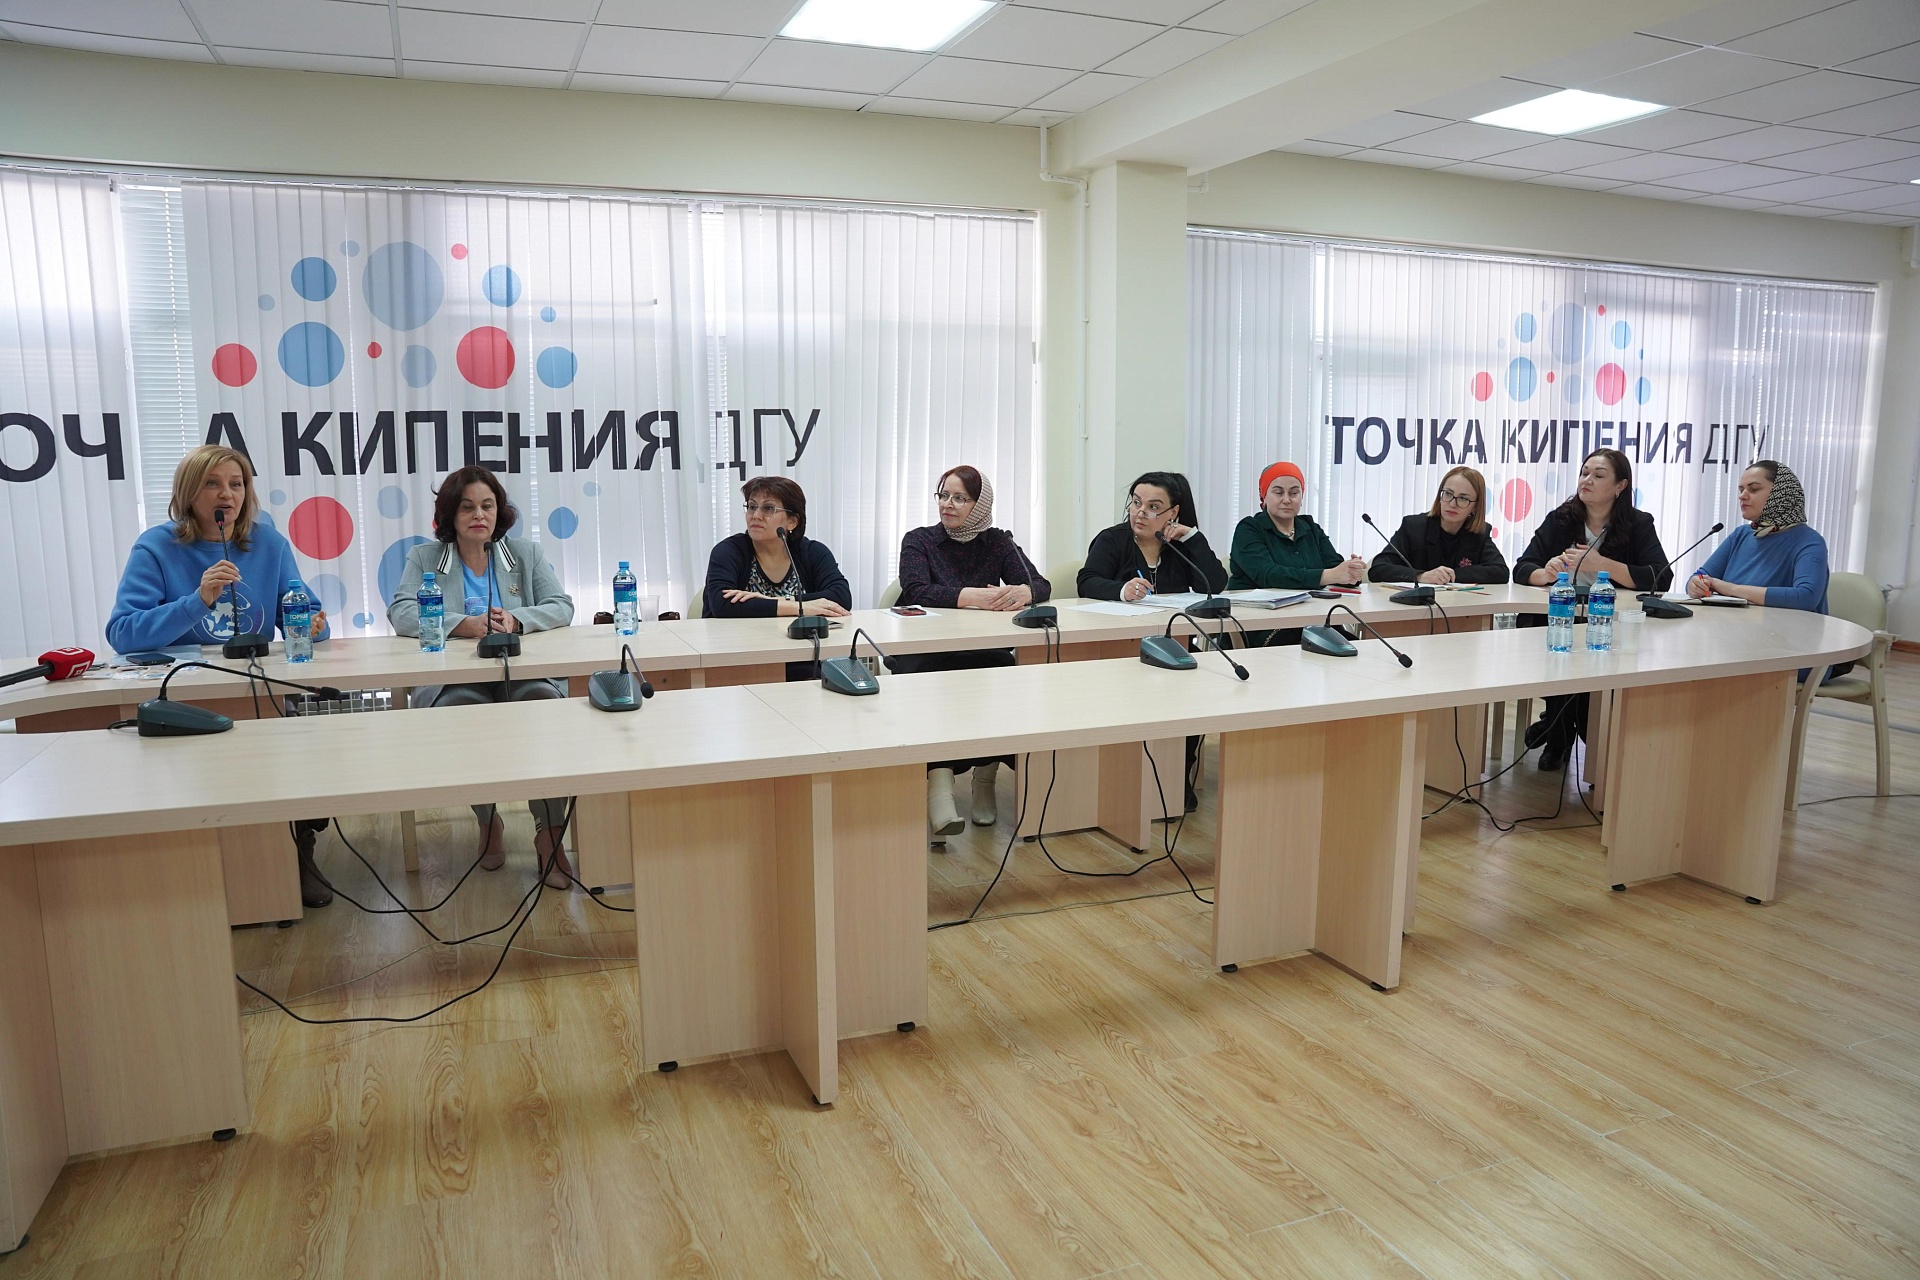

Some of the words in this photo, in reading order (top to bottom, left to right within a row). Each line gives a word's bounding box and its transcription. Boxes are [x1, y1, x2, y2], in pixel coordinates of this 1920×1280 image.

[281, 409, 681, 476] КИПЕНИЯ
[715, 408, 821, 481] ДГУ
[1324, 415, 1488, 466] ТОЧКА
[1501, 418, 1693, 464] КИПЕНИЯ
[1702, 423, 1770, 474] ДГУ
